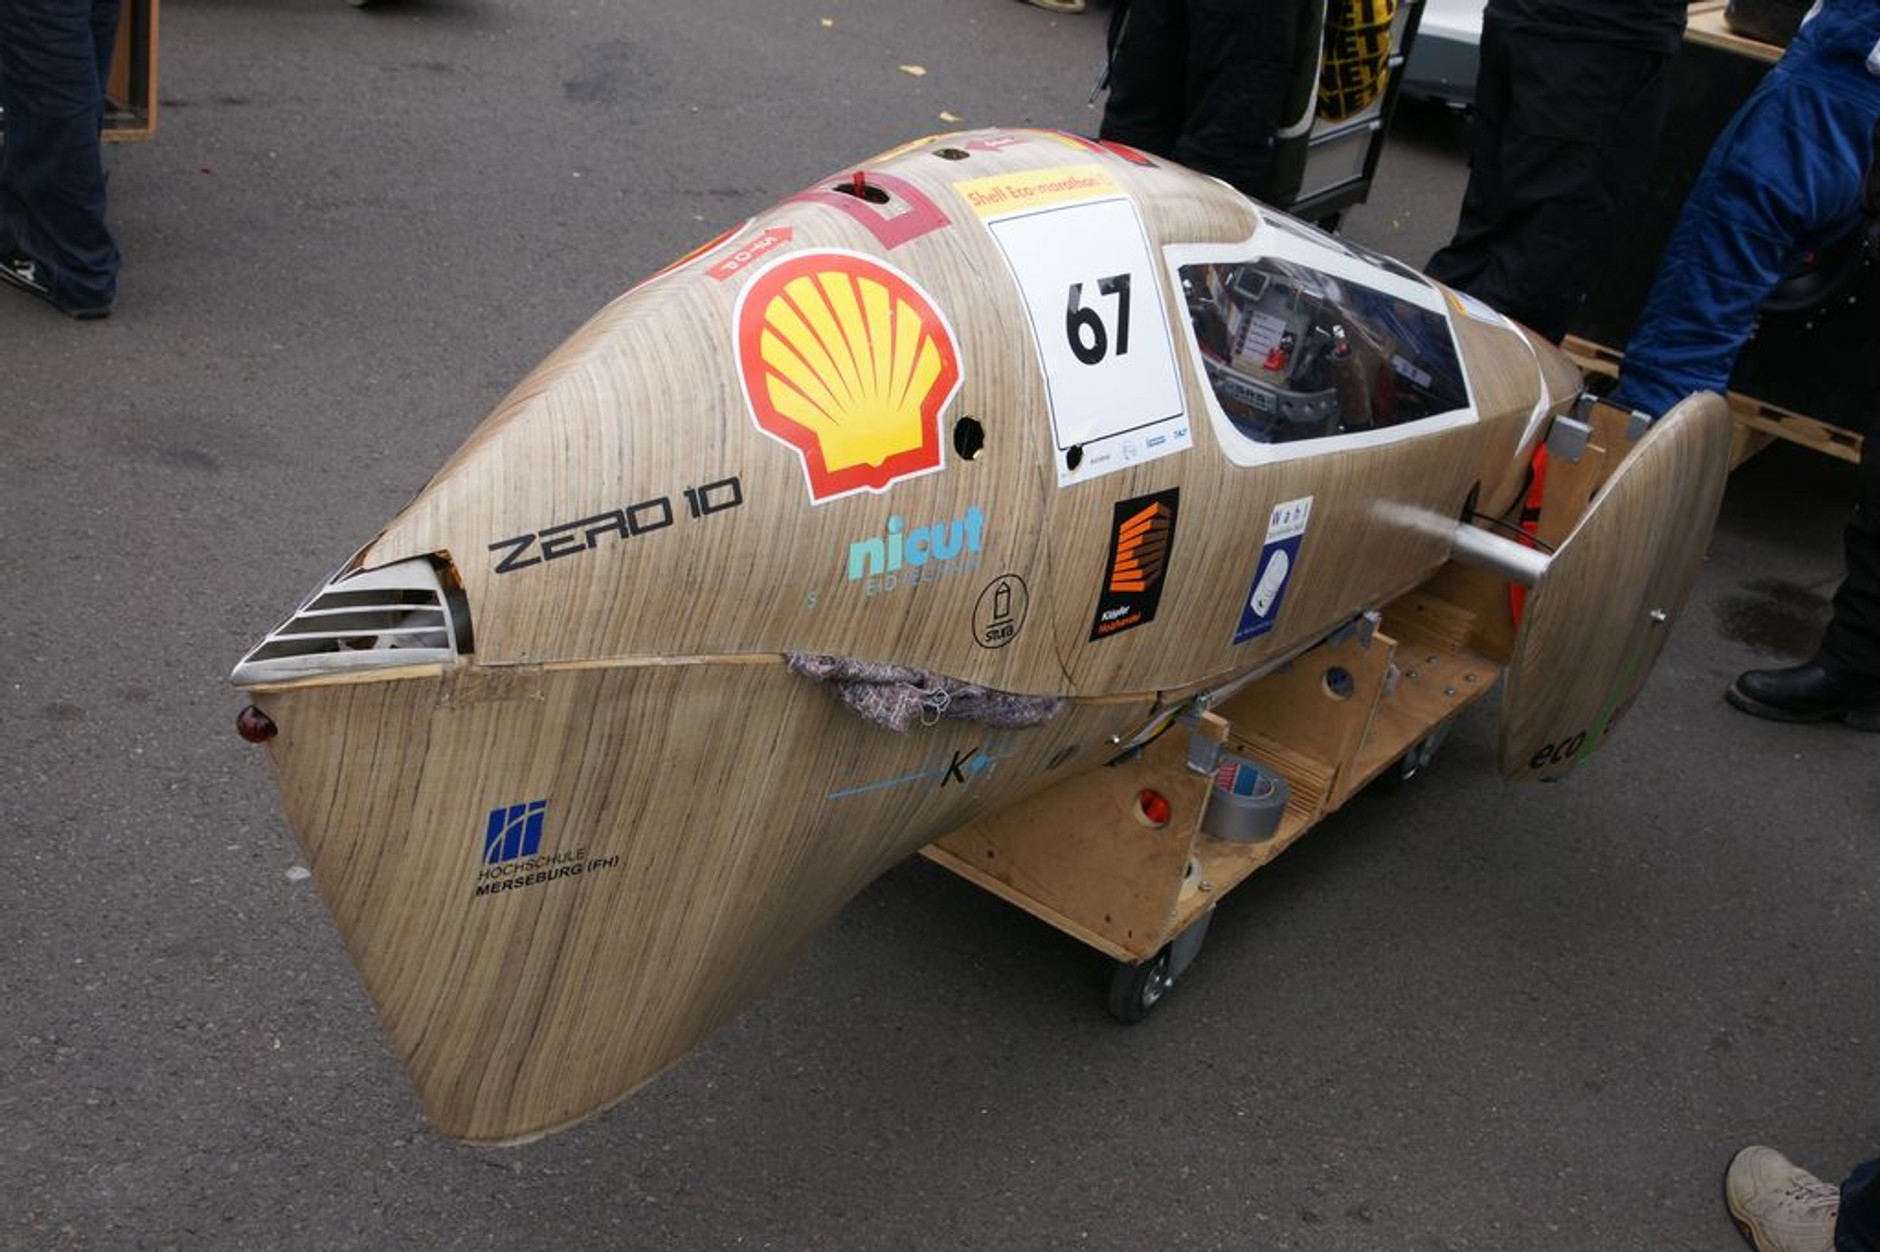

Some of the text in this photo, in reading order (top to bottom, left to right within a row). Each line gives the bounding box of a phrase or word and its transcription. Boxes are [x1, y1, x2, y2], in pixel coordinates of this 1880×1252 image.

[967, 187, 1007, 206] Shell
[1066, 273, 1131, 365] 67
[488, 476, 743, 574] ZERO 10
[848, 504, 985, 582] nicut
[475, 854, 620, 897] MERSEBURG (FH)
[478, 847, 586, 881] HOCHSCHULE
